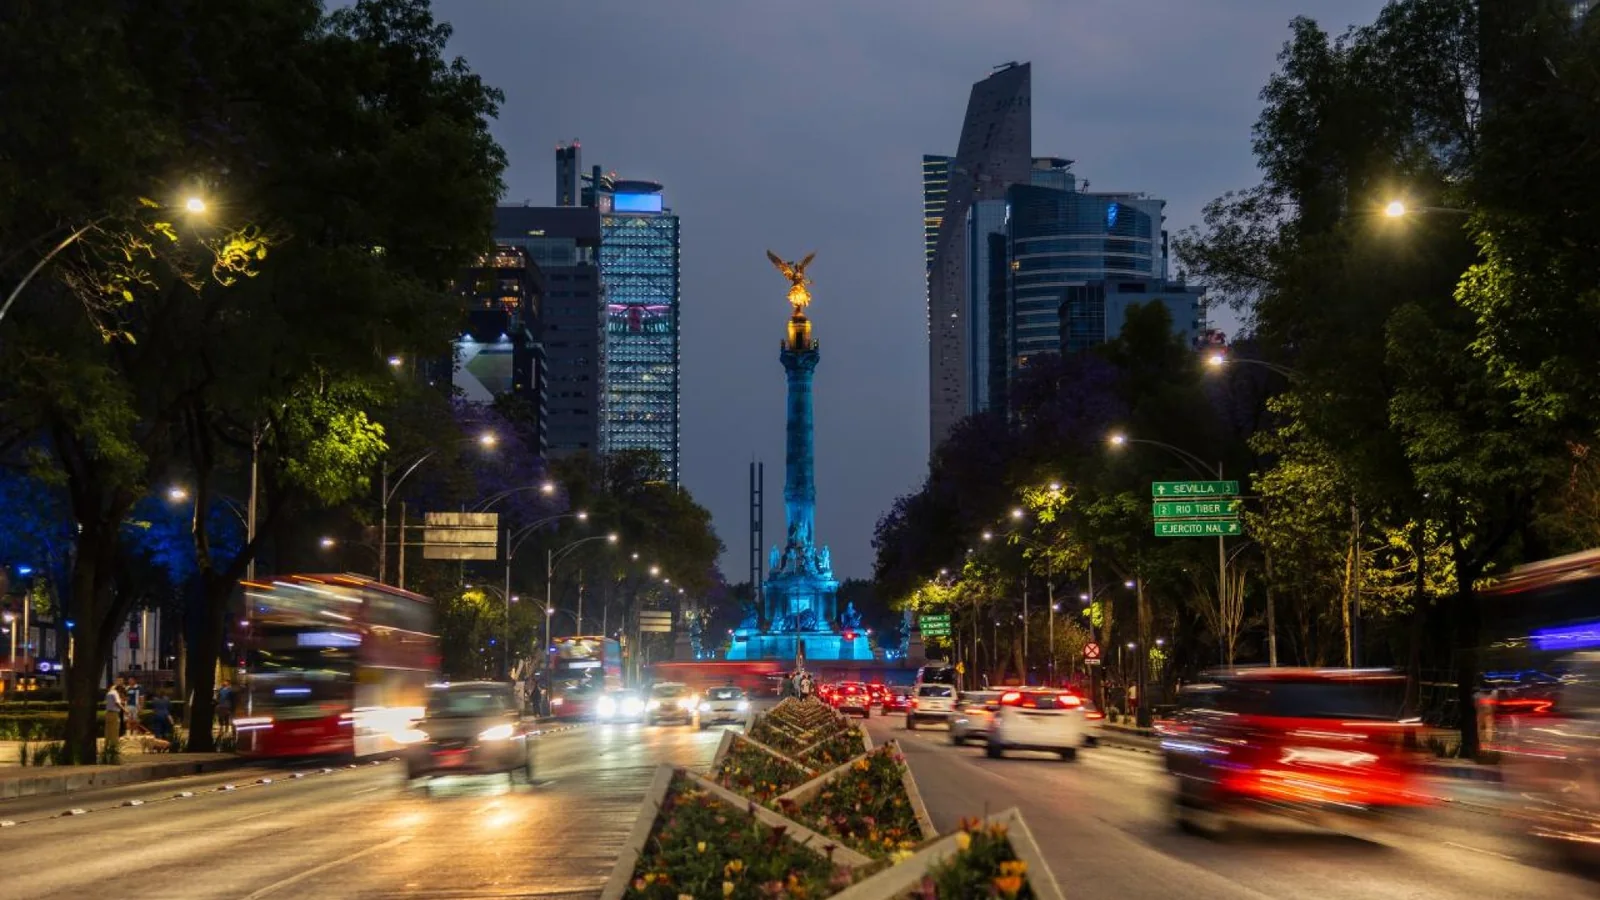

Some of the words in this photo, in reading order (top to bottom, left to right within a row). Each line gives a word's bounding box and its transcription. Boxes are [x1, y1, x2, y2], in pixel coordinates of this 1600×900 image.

[1173, 484, 1215, 493] SEVILLA
[1176, 505, 1191, 514] RIO
[1195, 504, 1220, 513] TIBER
[1162, 524, 1202, 533] EJERCITO
[1206, 524, 1223, 533] NAL
